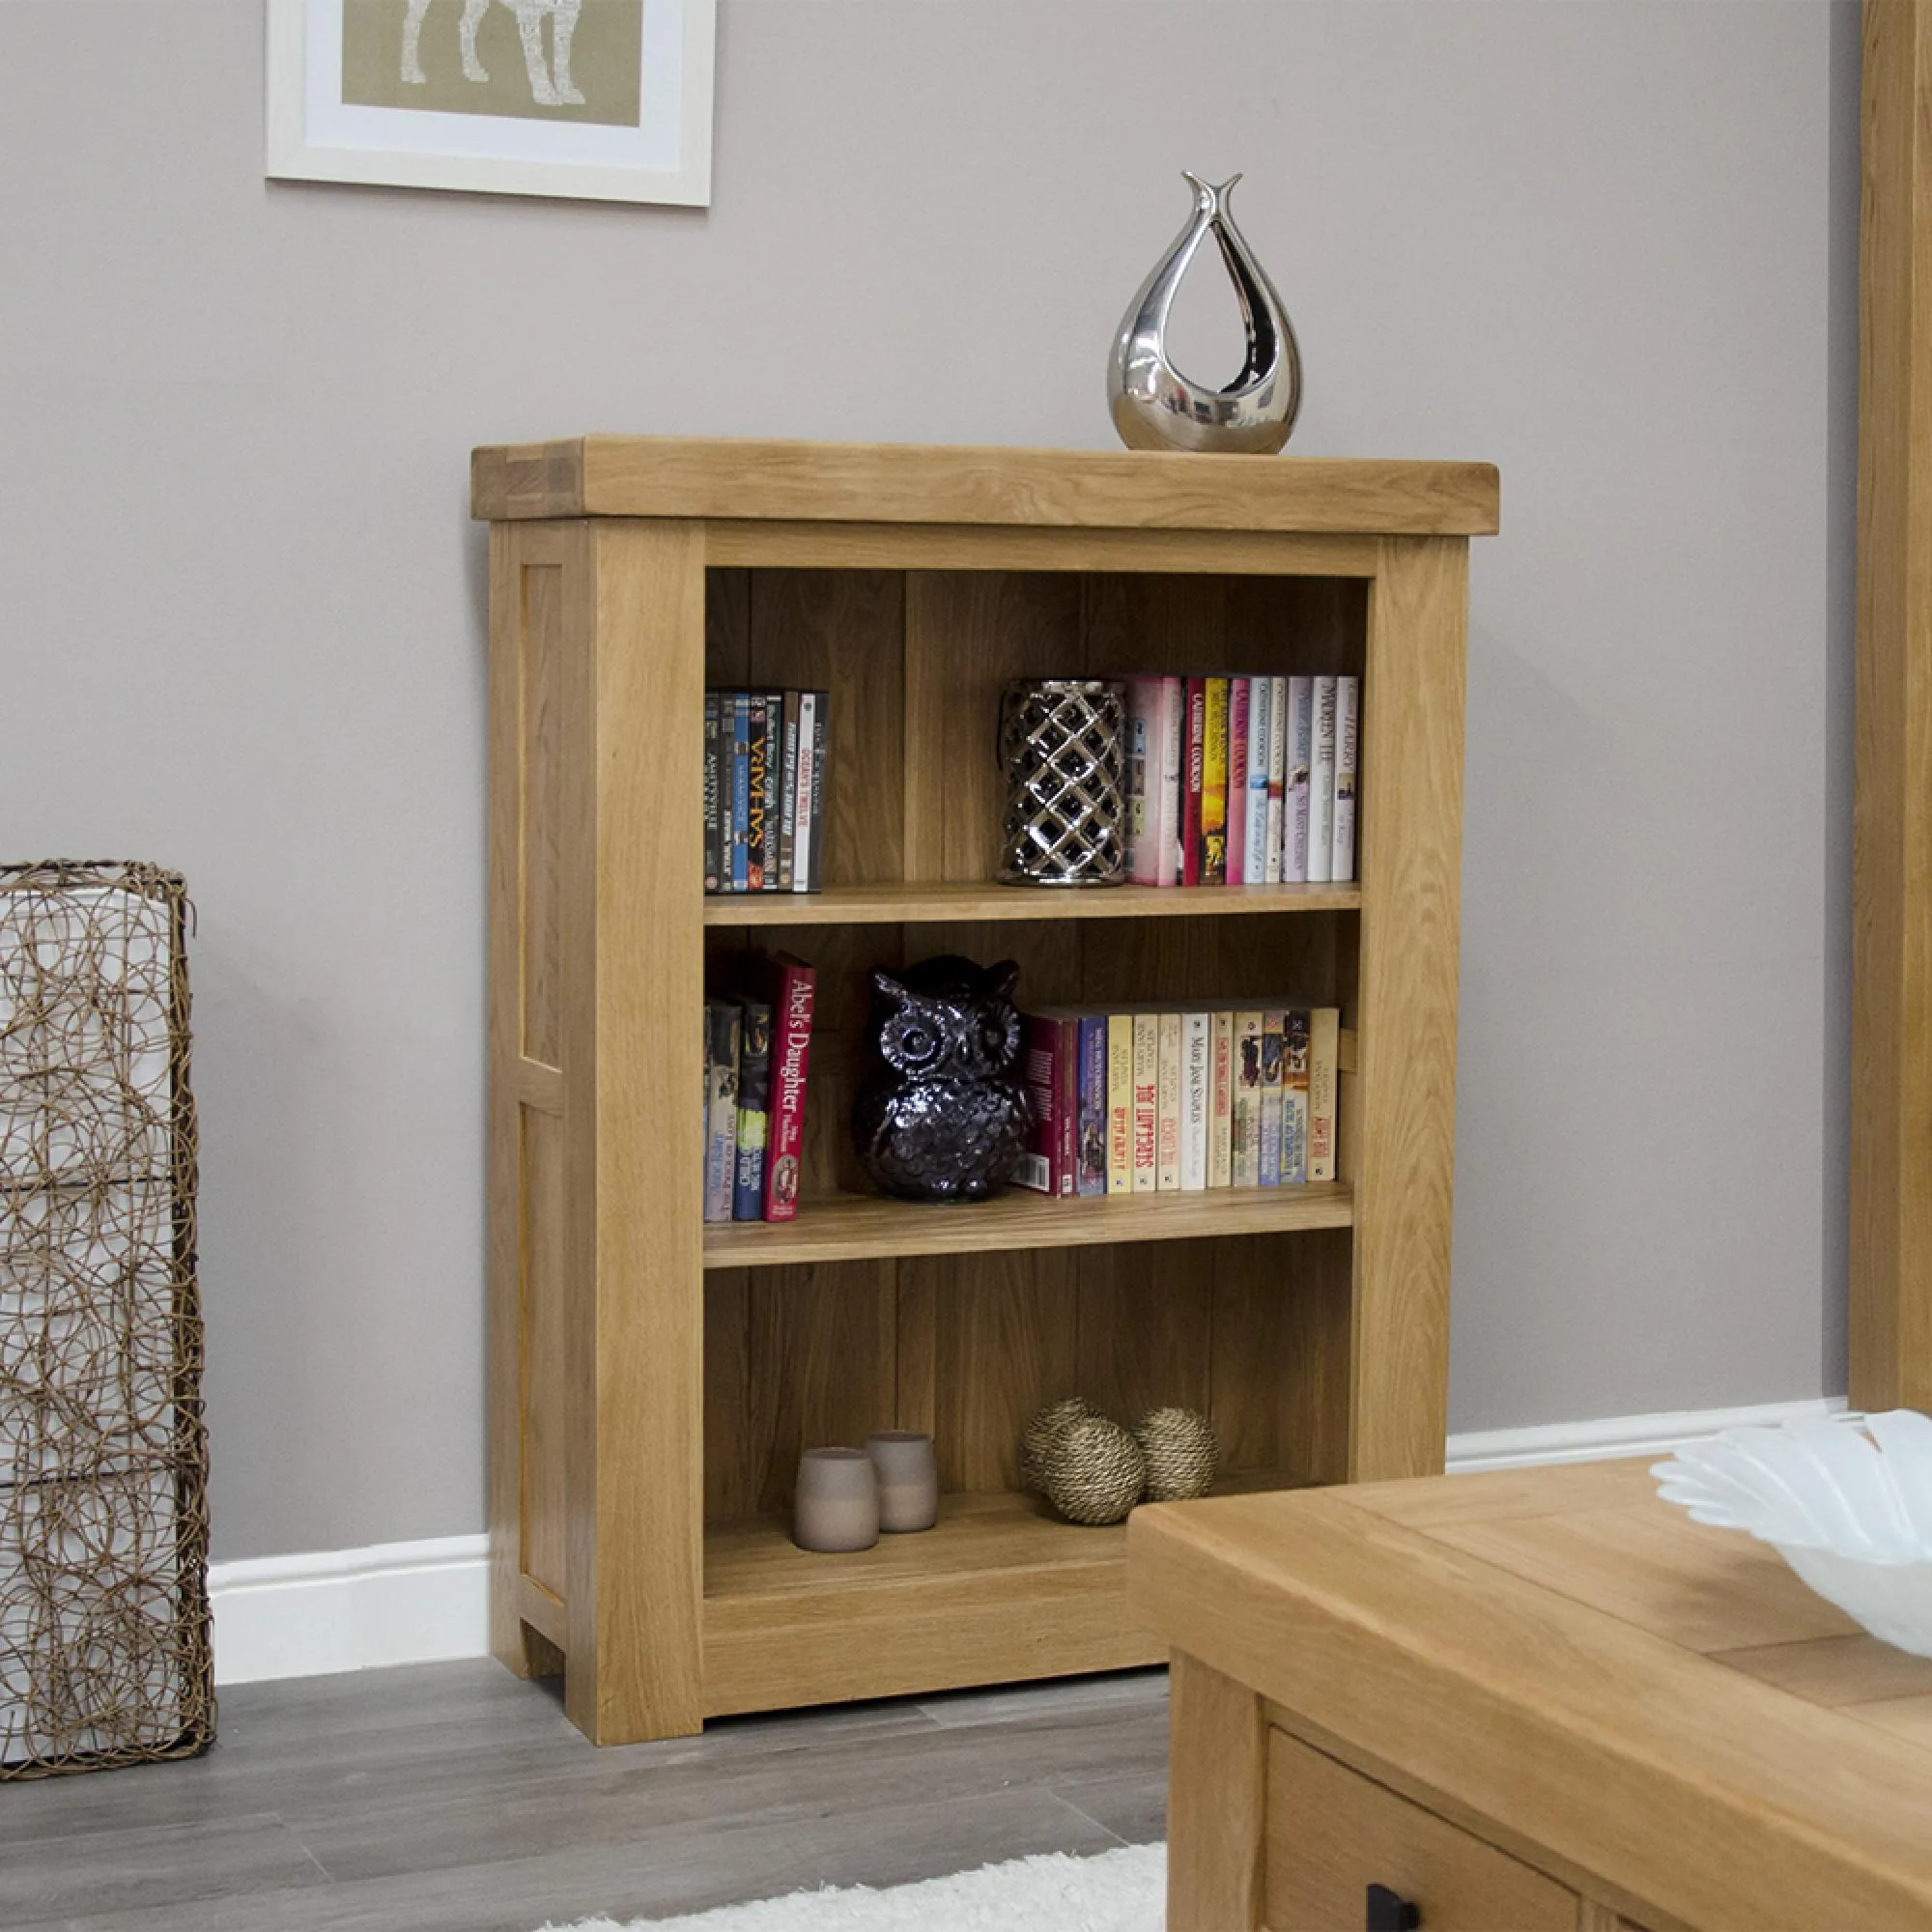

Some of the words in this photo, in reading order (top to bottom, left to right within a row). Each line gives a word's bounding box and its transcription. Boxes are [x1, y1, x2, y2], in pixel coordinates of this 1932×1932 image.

[749, 735, 765, 848] SAHARA
[788, 979, 813, 1029] Abel's
[780, 1033, 810, 1114] Daughter
[1135, 1084, 1155, 1105] JOE
[1135, 1108, 1154, 1168] SERGEANT
